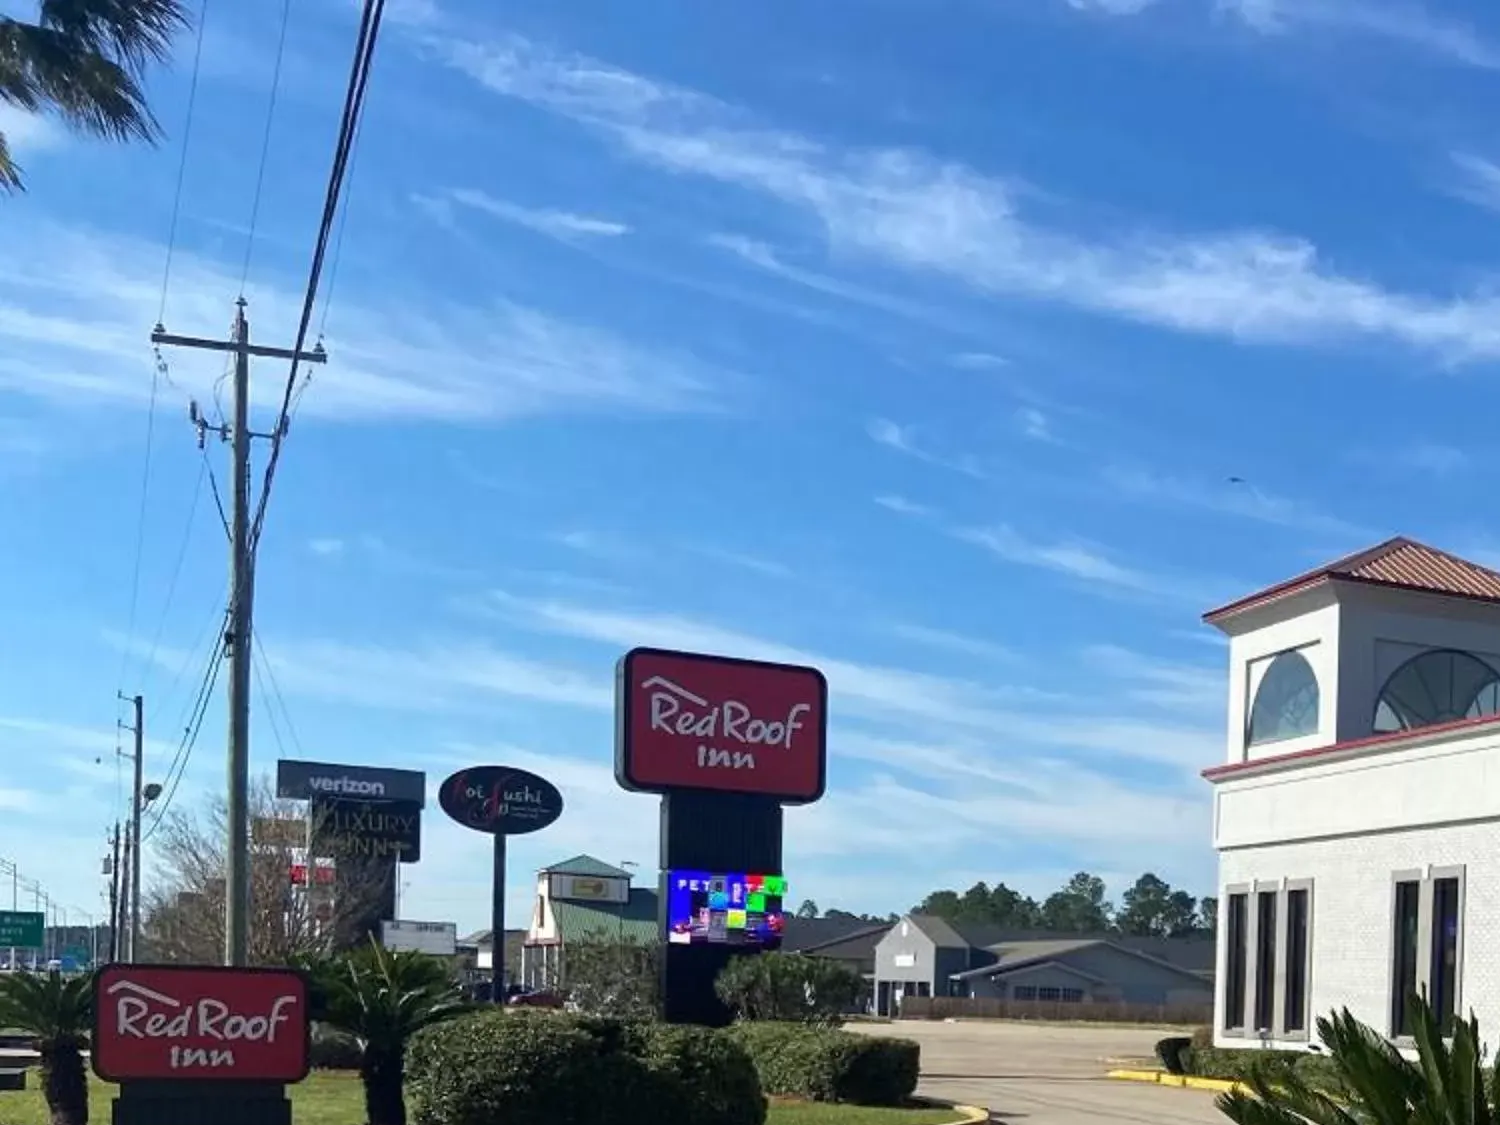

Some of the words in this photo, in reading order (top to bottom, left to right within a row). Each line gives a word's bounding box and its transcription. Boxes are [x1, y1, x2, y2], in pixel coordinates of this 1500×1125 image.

[651, 691, 720, 736] Red
[722, 700, 811, 750] Roof
[309, 775, 385, 796] verizon
[117, 996, 193, 1039] Red
[197, 995, 297, 1043] Roof
